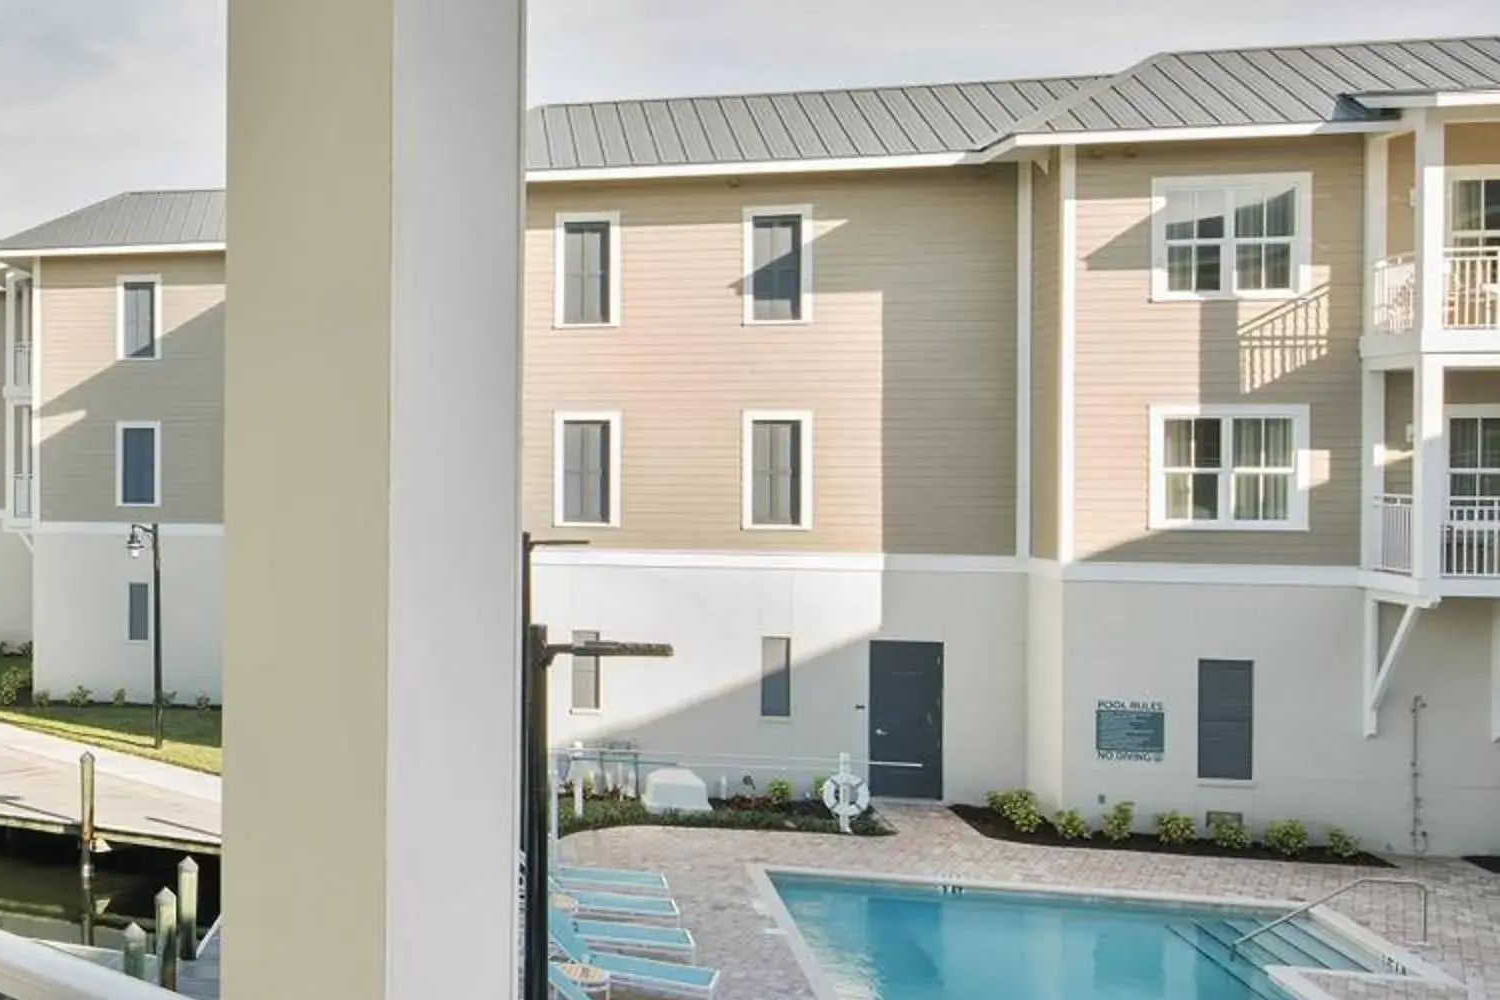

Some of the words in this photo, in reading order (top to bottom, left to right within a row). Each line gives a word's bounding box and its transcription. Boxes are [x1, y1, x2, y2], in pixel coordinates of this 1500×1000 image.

[1097, 700, 1126, 709] POOL
[1129, 701, 1163, 710] RULES
[1097, 750, 1114, 761] NO
[1115, 751, 1152, 762] DIVING
